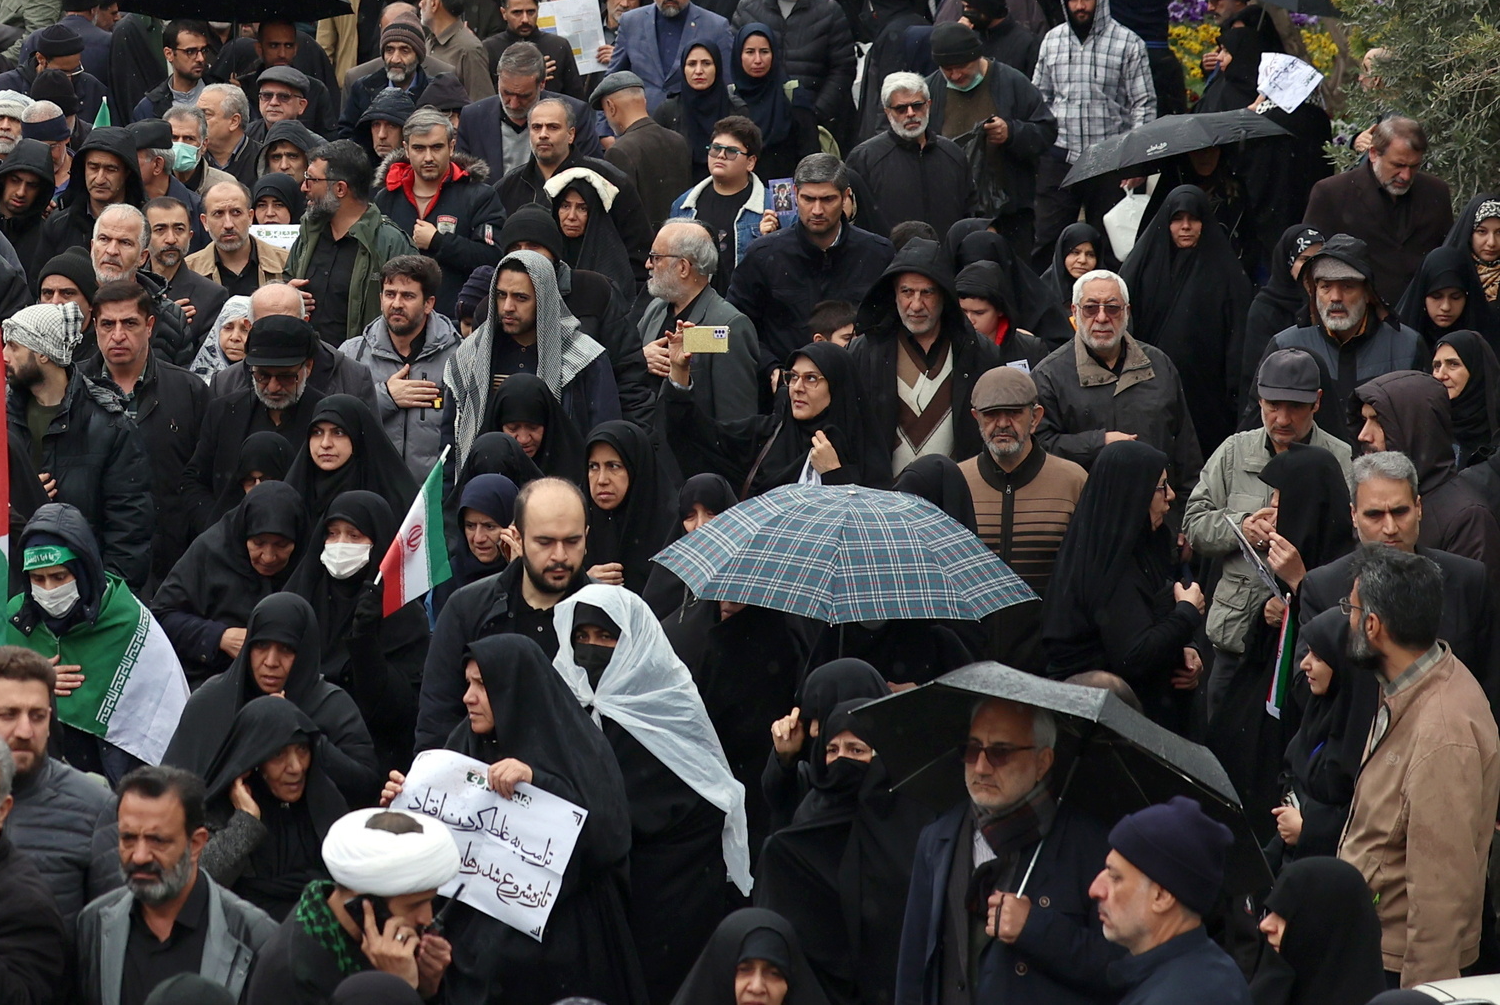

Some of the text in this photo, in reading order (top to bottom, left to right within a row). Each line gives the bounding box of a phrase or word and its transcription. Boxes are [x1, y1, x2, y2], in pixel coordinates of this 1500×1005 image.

[407, 786, 554, 868] ترامپ به غلط کردن افتاد
[496, 871, 532, 906] شروع
[516, 880, 553, 909] تازه
